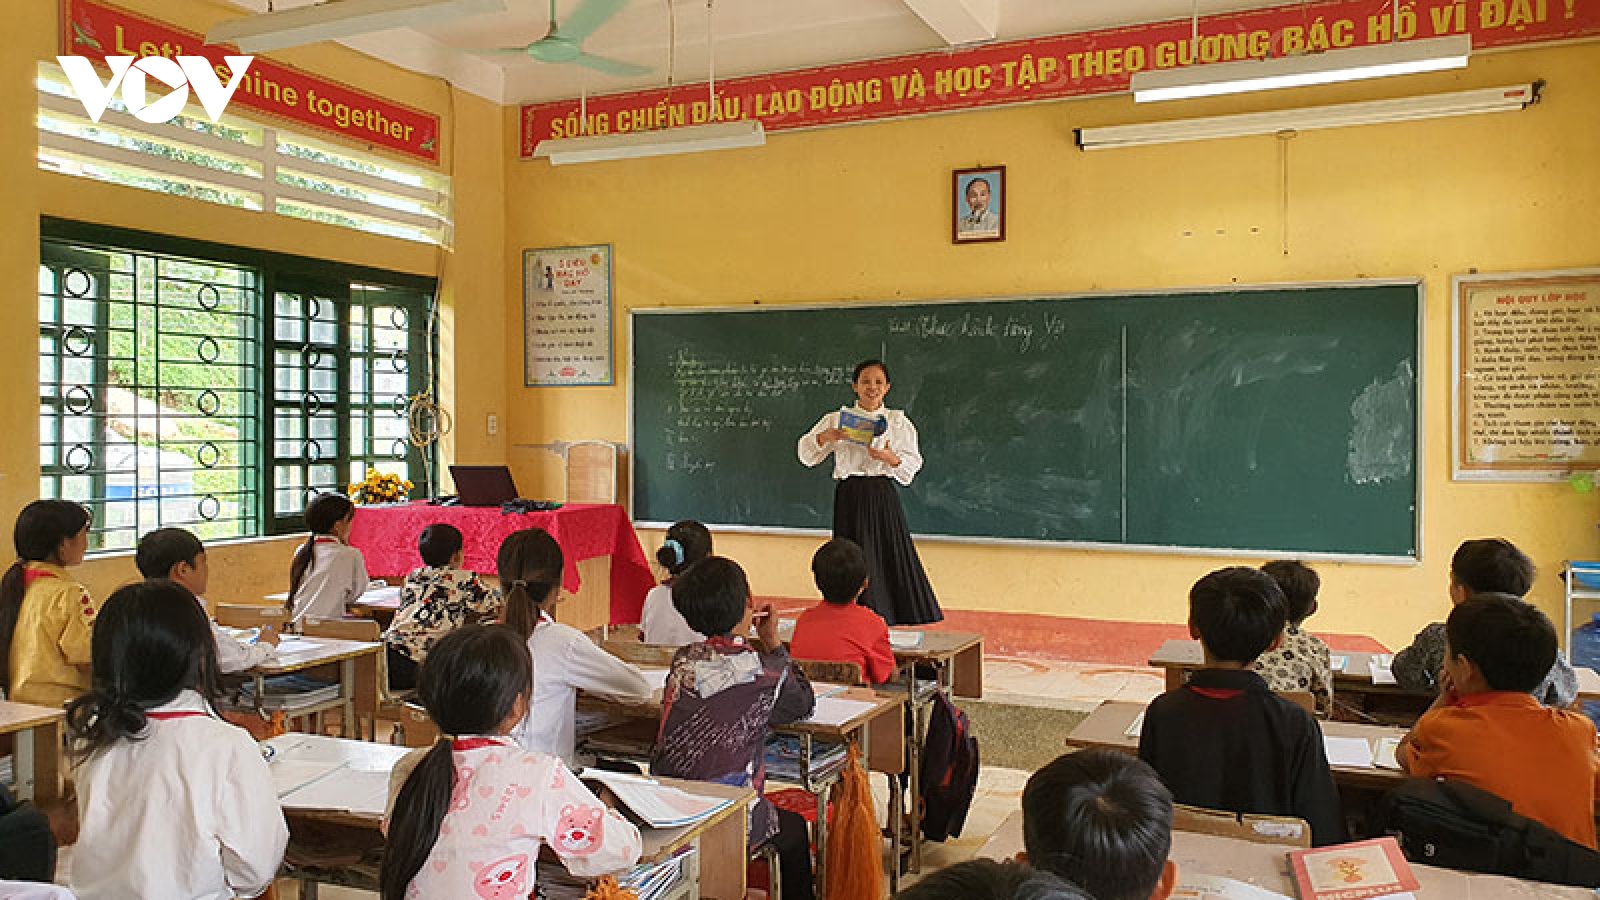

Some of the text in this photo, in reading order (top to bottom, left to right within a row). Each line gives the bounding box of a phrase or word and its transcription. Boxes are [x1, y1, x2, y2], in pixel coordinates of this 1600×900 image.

[306, 90, 414, 141] together
[551, 108, 609, 139] SỐNG
[616, 98, 686, 133] CHIẾN
[755, 89, 802, 117] LAO
[811, 78, 882, 113] ĐỘNG
[890, 68, 926, 100] VÀ
[935, 64, 992, 97] HỌC
[1002, 54, 1057, 90] TẬP
[1068, 46, 1145, 79] THEO
[1156, 31, 1270, 68] GƯƠNG
[1282, 16, 1354, 54] BÁC
[1367, 1, 1417, 43] HỒ
[1480, 0, 1547, 31] ĐẠI
